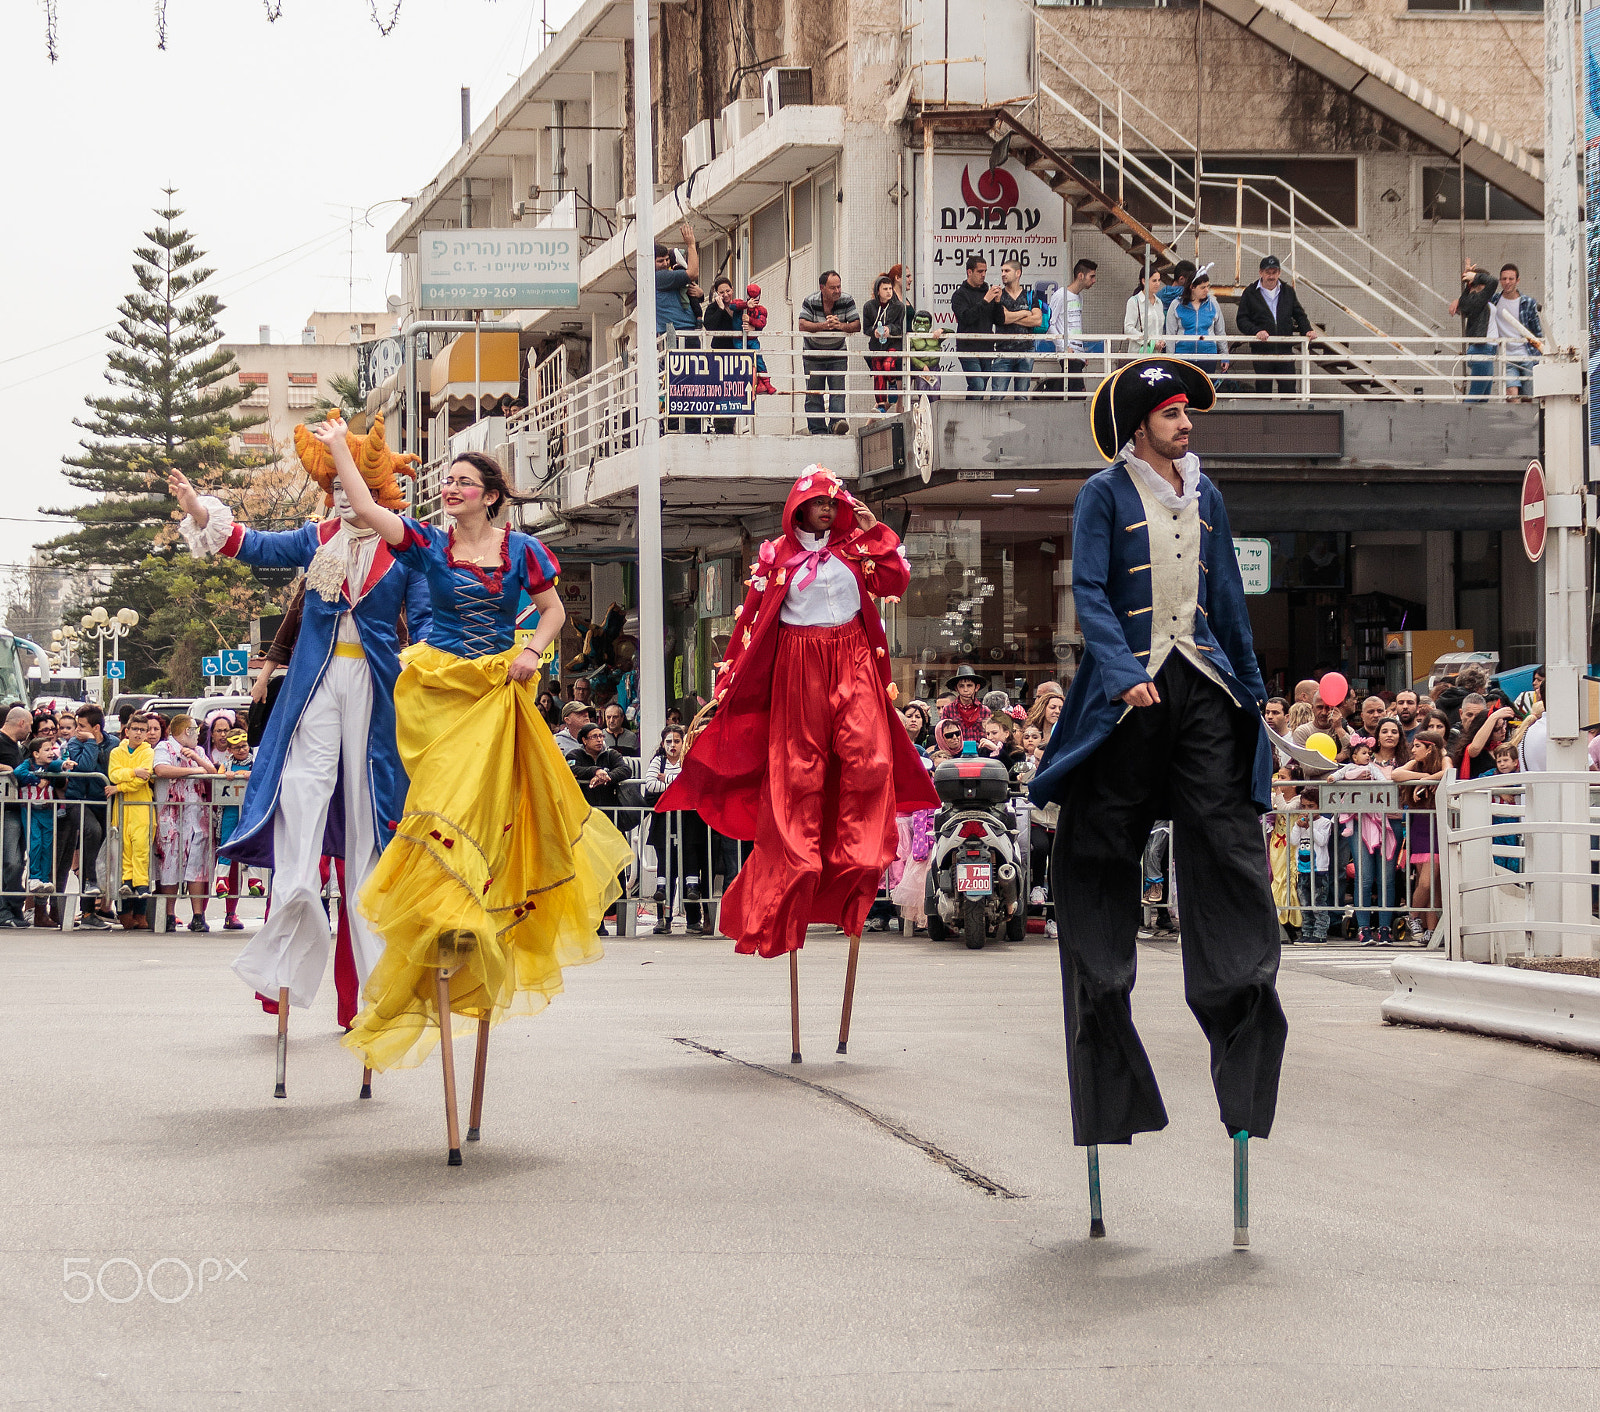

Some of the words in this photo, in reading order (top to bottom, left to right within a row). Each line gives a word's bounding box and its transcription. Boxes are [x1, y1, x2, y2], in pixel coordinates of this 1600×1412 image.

[940, 207, 1041, 233] ערבובים
[985, 235, 1023, 245] האקדמית
[1025, 234, 1057, 244] המכללה
[453, 241, 500, 256] נהריה
[506, 241, 570, 256] פנורמה
[453, 261, 477, 272] C.T.
[495, 261, 530, 272] שיניים
[533, 260, 570, 272] צילומי
[429, 287, 517, 298] 04-99-29-269
[669, 355, 710, 375] ברוש
[714, 355, 753, 382] תיווך
[358, 345, 367, 399] TATTOO
[723, 381, 745, 397] БРОШ
[670, 401, 715, 412] 9927007
